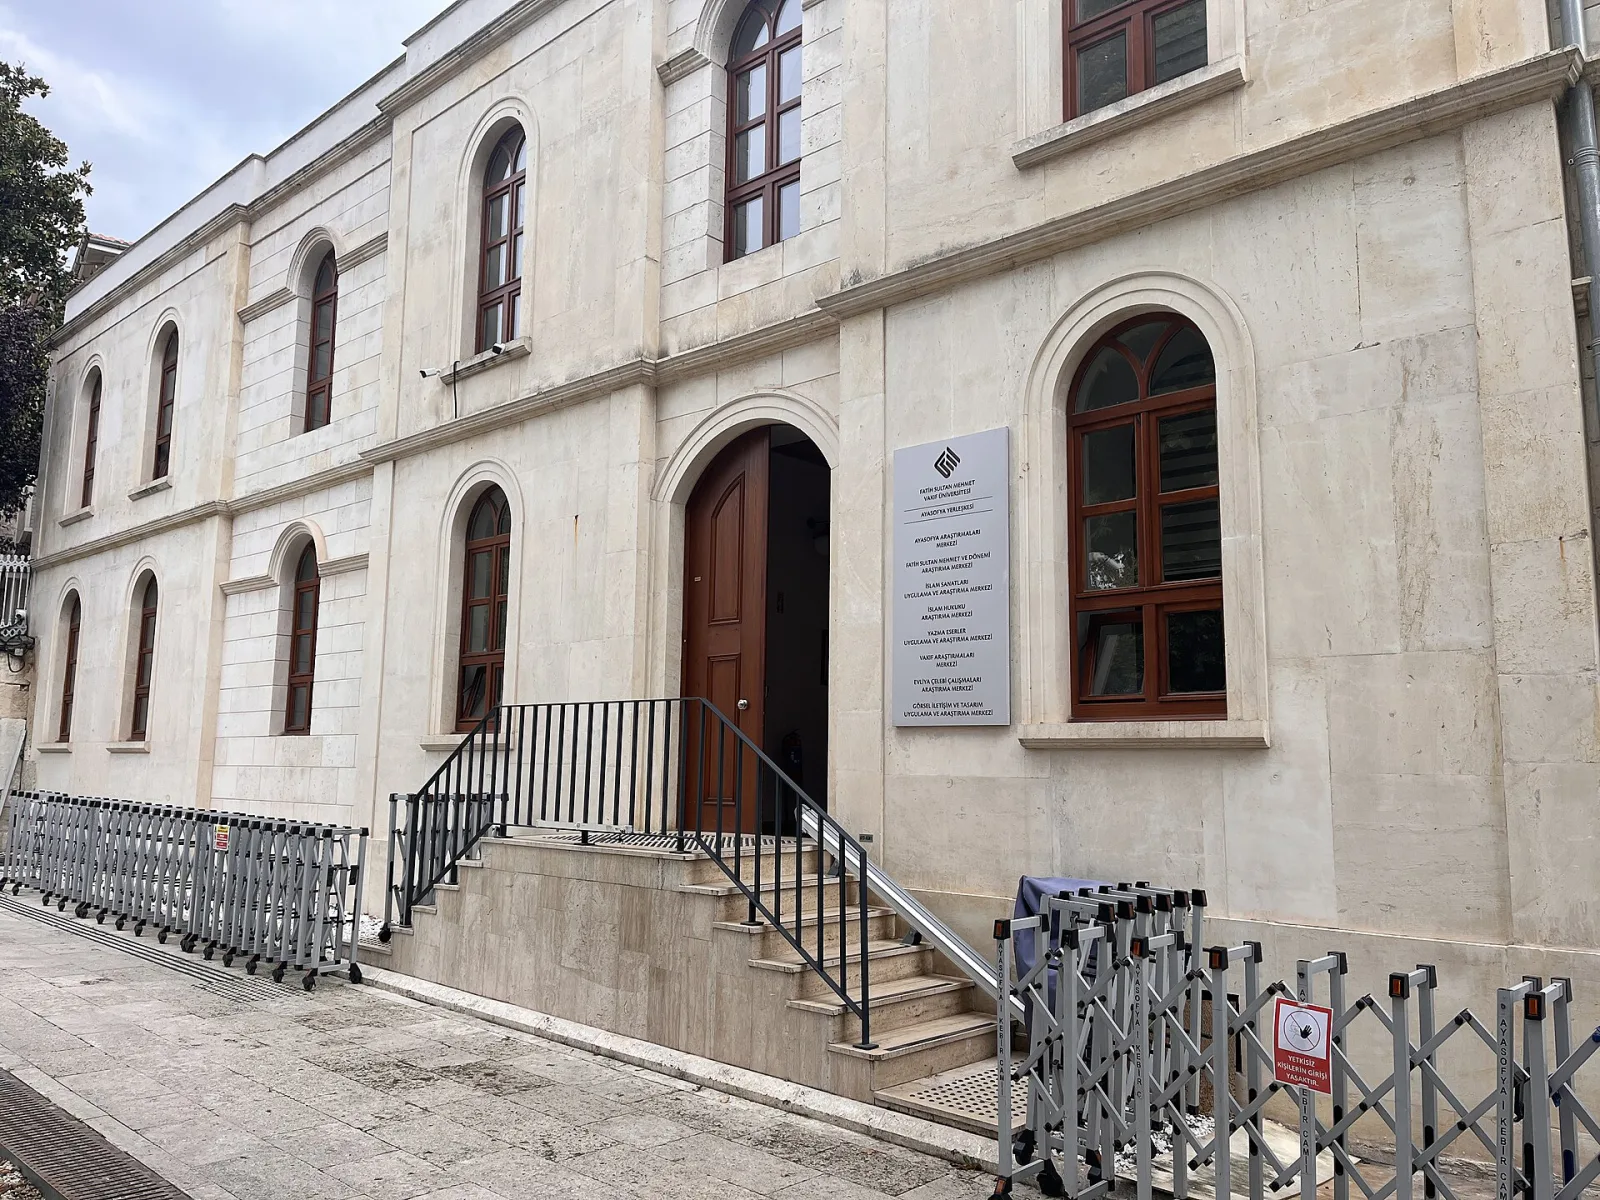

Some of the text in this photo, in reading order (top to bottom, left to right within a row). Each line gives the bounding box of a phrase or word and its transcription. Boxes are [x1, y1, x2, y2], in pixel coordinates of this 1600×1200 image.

[920, 480, 976, 495] FATİH SULTAN MEHMET
[924, 493, 939, 501] VAKIF
[921, 503, 974, 518] AYASOFYA YERLEŞKESİ
[915, 529, 980, 544] AYASOFYA ARAŞTIRMALARI
[936, 540, 958, 548] MERKEZİ
[906, 560, 919, 568] FATİH
[920, 558, 938, 566] SULTAN
[939, 556, 960, 564] MEHMET
[969, 551, 990, 560] DÖNEMİ
[922, 562, 973, 574] ARAŞTIRMA MERKEZİ
[941, 579, 969, 588] SANATLARI
[904, 590, 932, 599] UYGULAMA
[940, 587, 969, 596] ARAŞTIRMA
[970, 584, 993, 592] MERKEZİ
[921, 610, 973, 621] ARAŞTIRMA MERKEZİ
[940, 636, 969, 644] ARAŞTIRMA
[970, 633, 993, 641] MERKEZİ
[934, 652, 974, 660] ARAŞTIRMALARI
[947, 677, 981, 685] ÇALIŞMALARI
[1288, 1055, 1315, 1067] YETKİSİZ
[1278, 1062, 1327, 1080] KİŞİLERİN GİRİŞİ
[1286, 1073, 1319, 1086] YASAKTIR.
